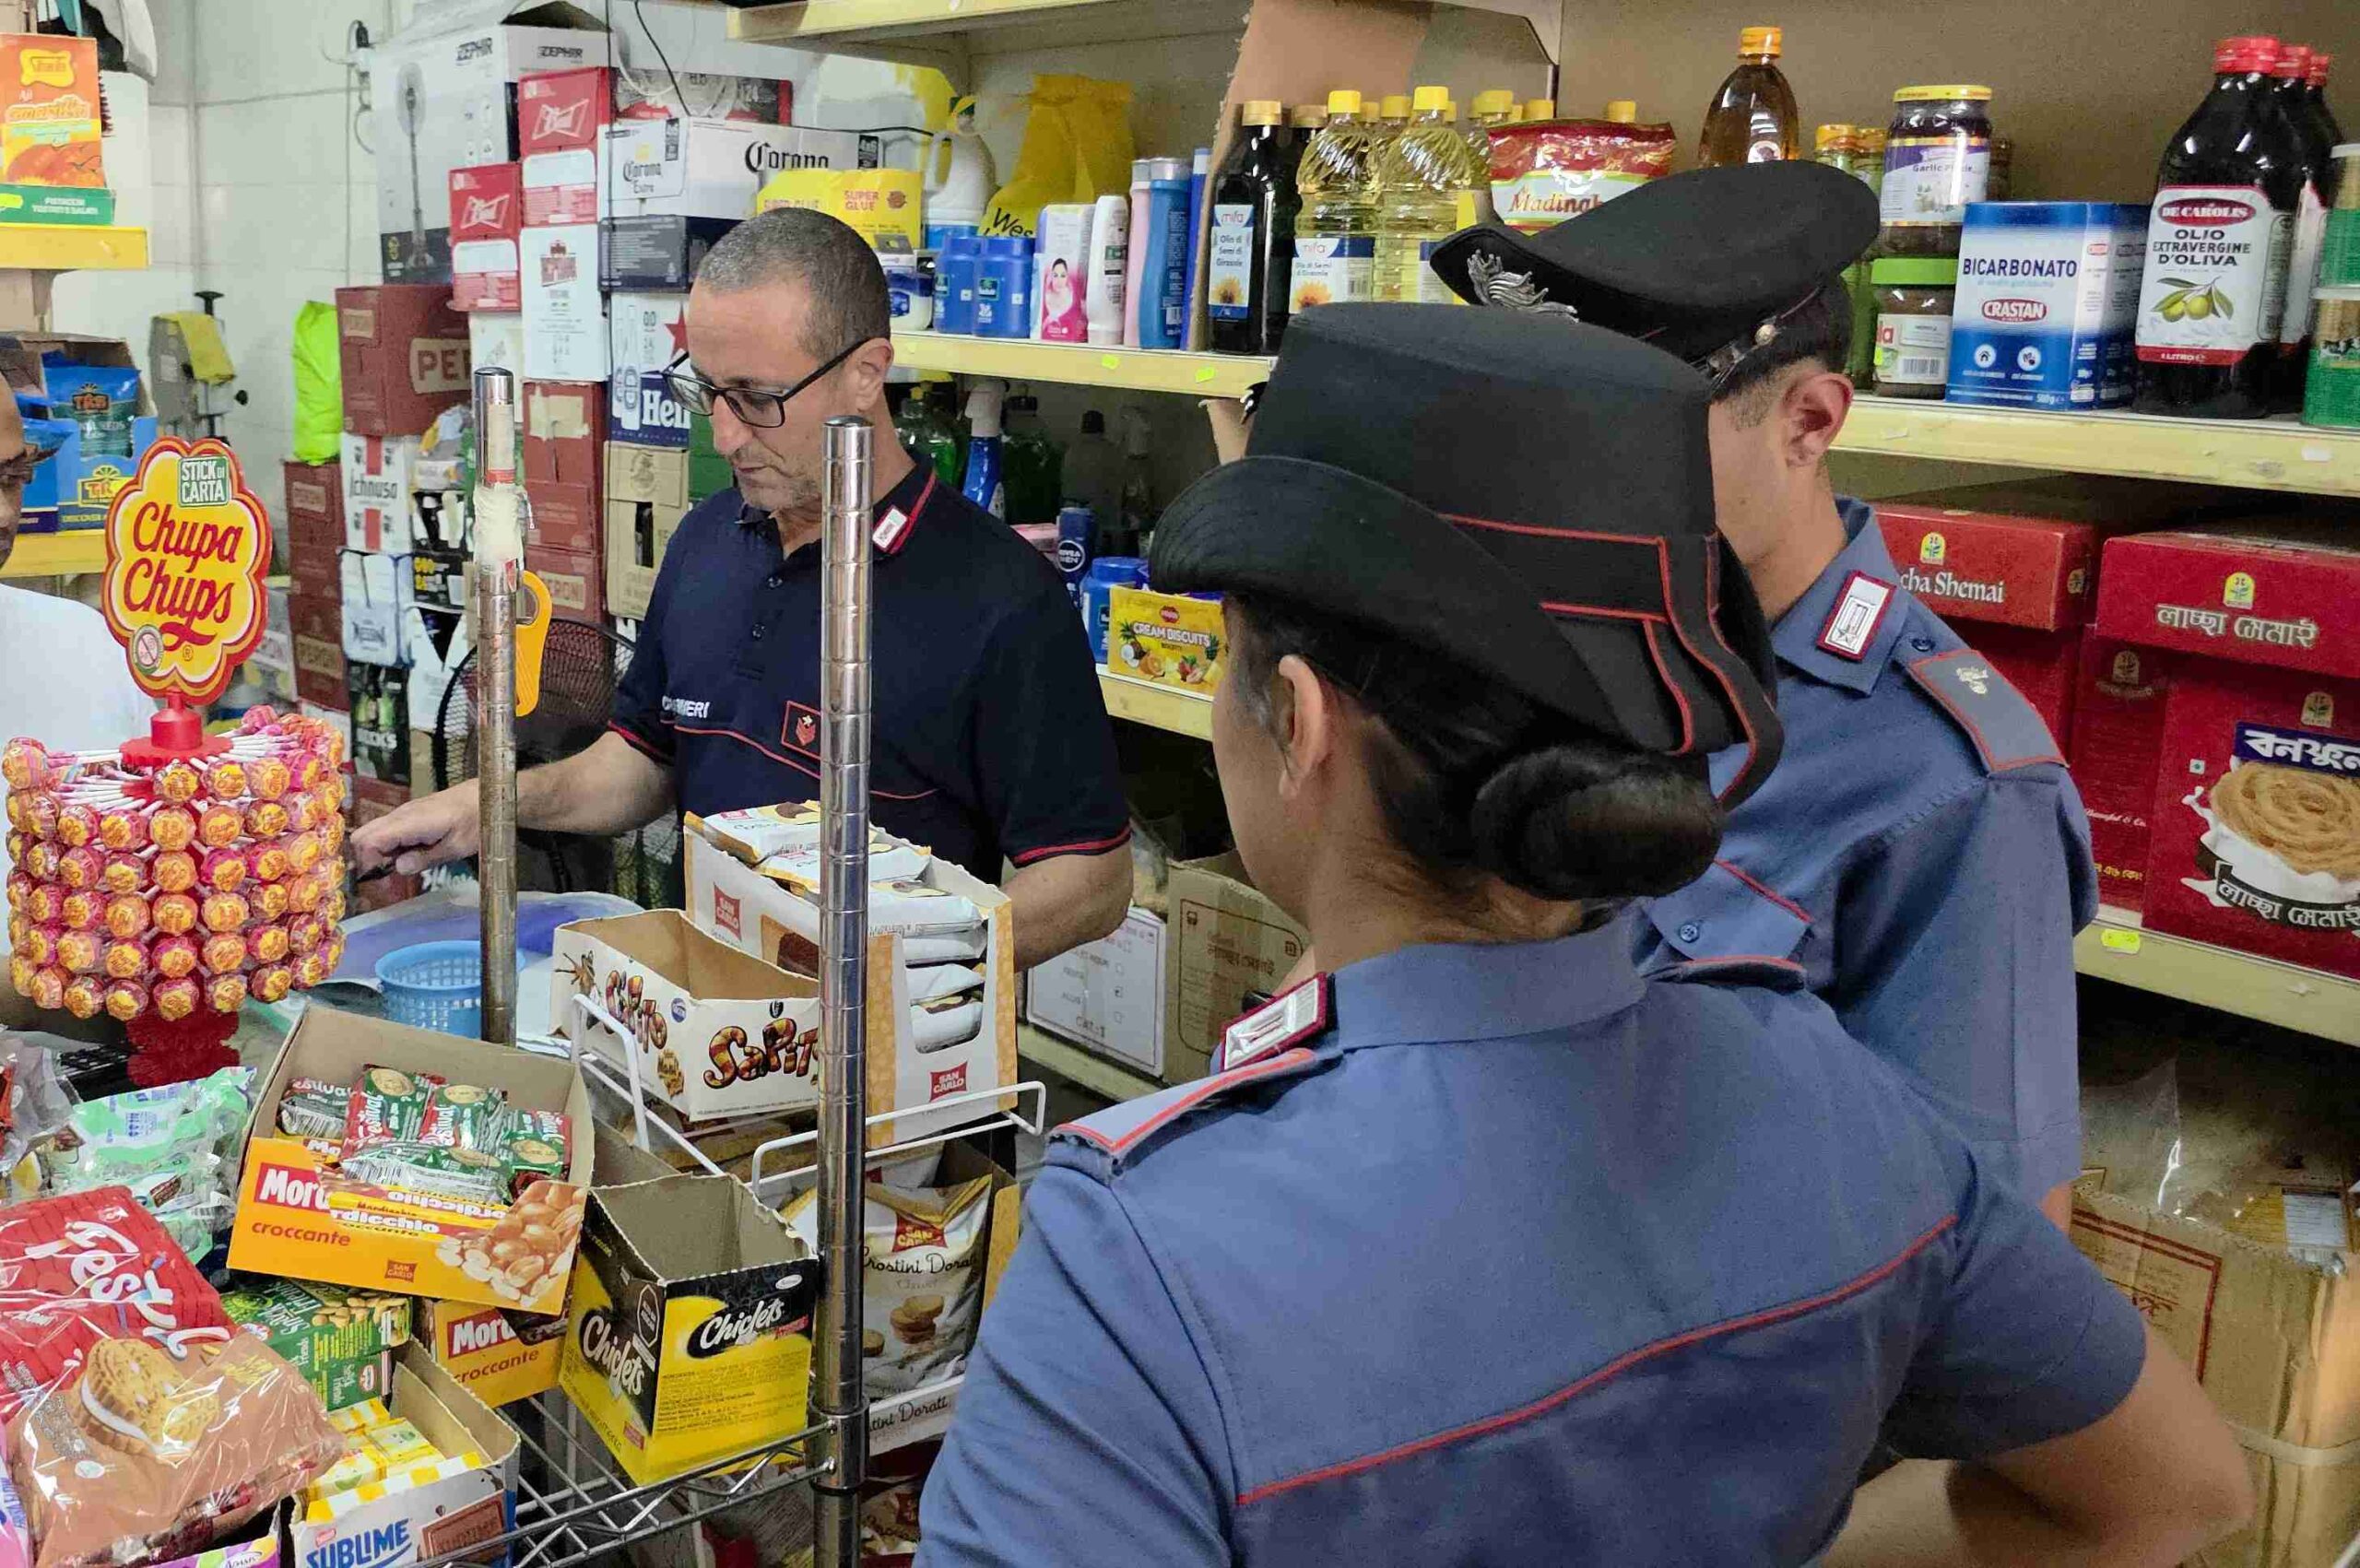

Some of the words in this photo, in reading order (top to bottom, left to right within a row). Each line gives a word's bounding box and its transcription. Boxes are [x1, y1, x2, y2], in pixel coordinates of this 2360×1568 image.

[538, 45, 583, 58] ZEPHIR
[746, 141, 830, 173] Corona
[1912, 162, 1941, 172] Garlic
[844, 190, 879, 201] SUPER
[845, 201, 875, 211] GLUE
[2162, 206, 2177, 218] DE
[2181, 206, 2248, 218] CAROLIS
[1221, 212, 1244, 223] mifa
[1220, 235, 1234, 243] Olio
[2175, 229, 2225, 241] OLIO
[1219, 246, 1234, 254] Semi
[2153, 241, 2251, 253] EXTRAVERGINE
[1216, 258, 1243, 266] Girasole
[1963, 258, 2077, 277] BICARBONATO
[2158, 254, 2238, 266] D'OLIVA
[1984, 301, 2044, 318] CRASTAN
[182, 460, 216, 483] STICK
[182, 477, 224, 502] CARTA
[133, 501, 244, 573] Chupa
[124, 557, 236, 631] Chups
[1934, 572, 2005, 604] Shemai
[1133, 622, 1166, 637] CREAM
[1167, 628, 1210, 646] BISCUITS
[938, 1071, 960, 1082] SAN
[933, 1078, 964, 1093] CARLO
[252, 1221, 351, 1246] croccante
[387, 1269, 413, 1279] CARLO
[392, 1263, 409, 1272] SAN
[700, 1298, 785, 1350] Chiclets
[583, 1315, 644, 1396] Chiclets
[454, 1350, 539, 1383] croccante
[898, 1396, 948, 1422] Dorati
[306, 1517, 411, 1568] SUBLIME
